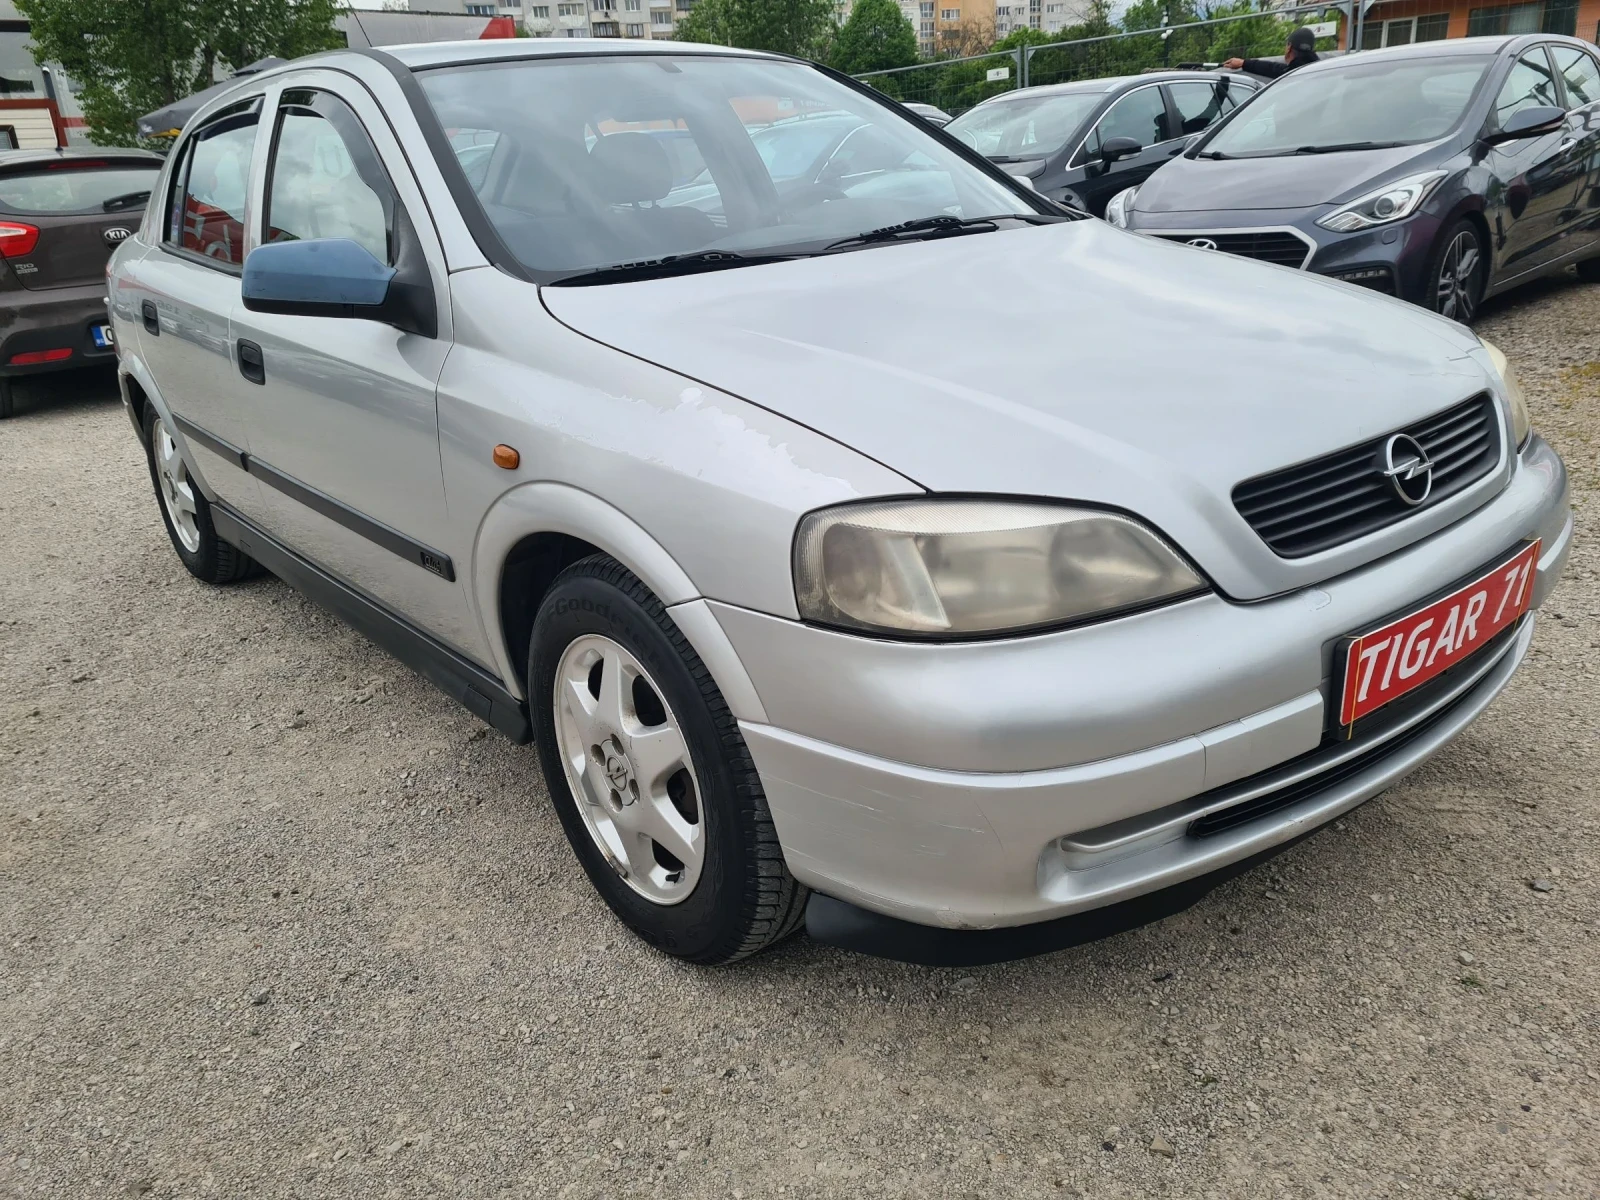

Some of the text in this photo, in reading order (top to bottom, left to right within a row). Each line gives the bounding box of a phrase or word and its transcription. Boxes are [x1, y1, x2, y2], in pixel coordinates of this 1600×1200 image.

[108, 230, 128, 240] KIA
[1358, 556, 1533, 702] TIGAR 71
